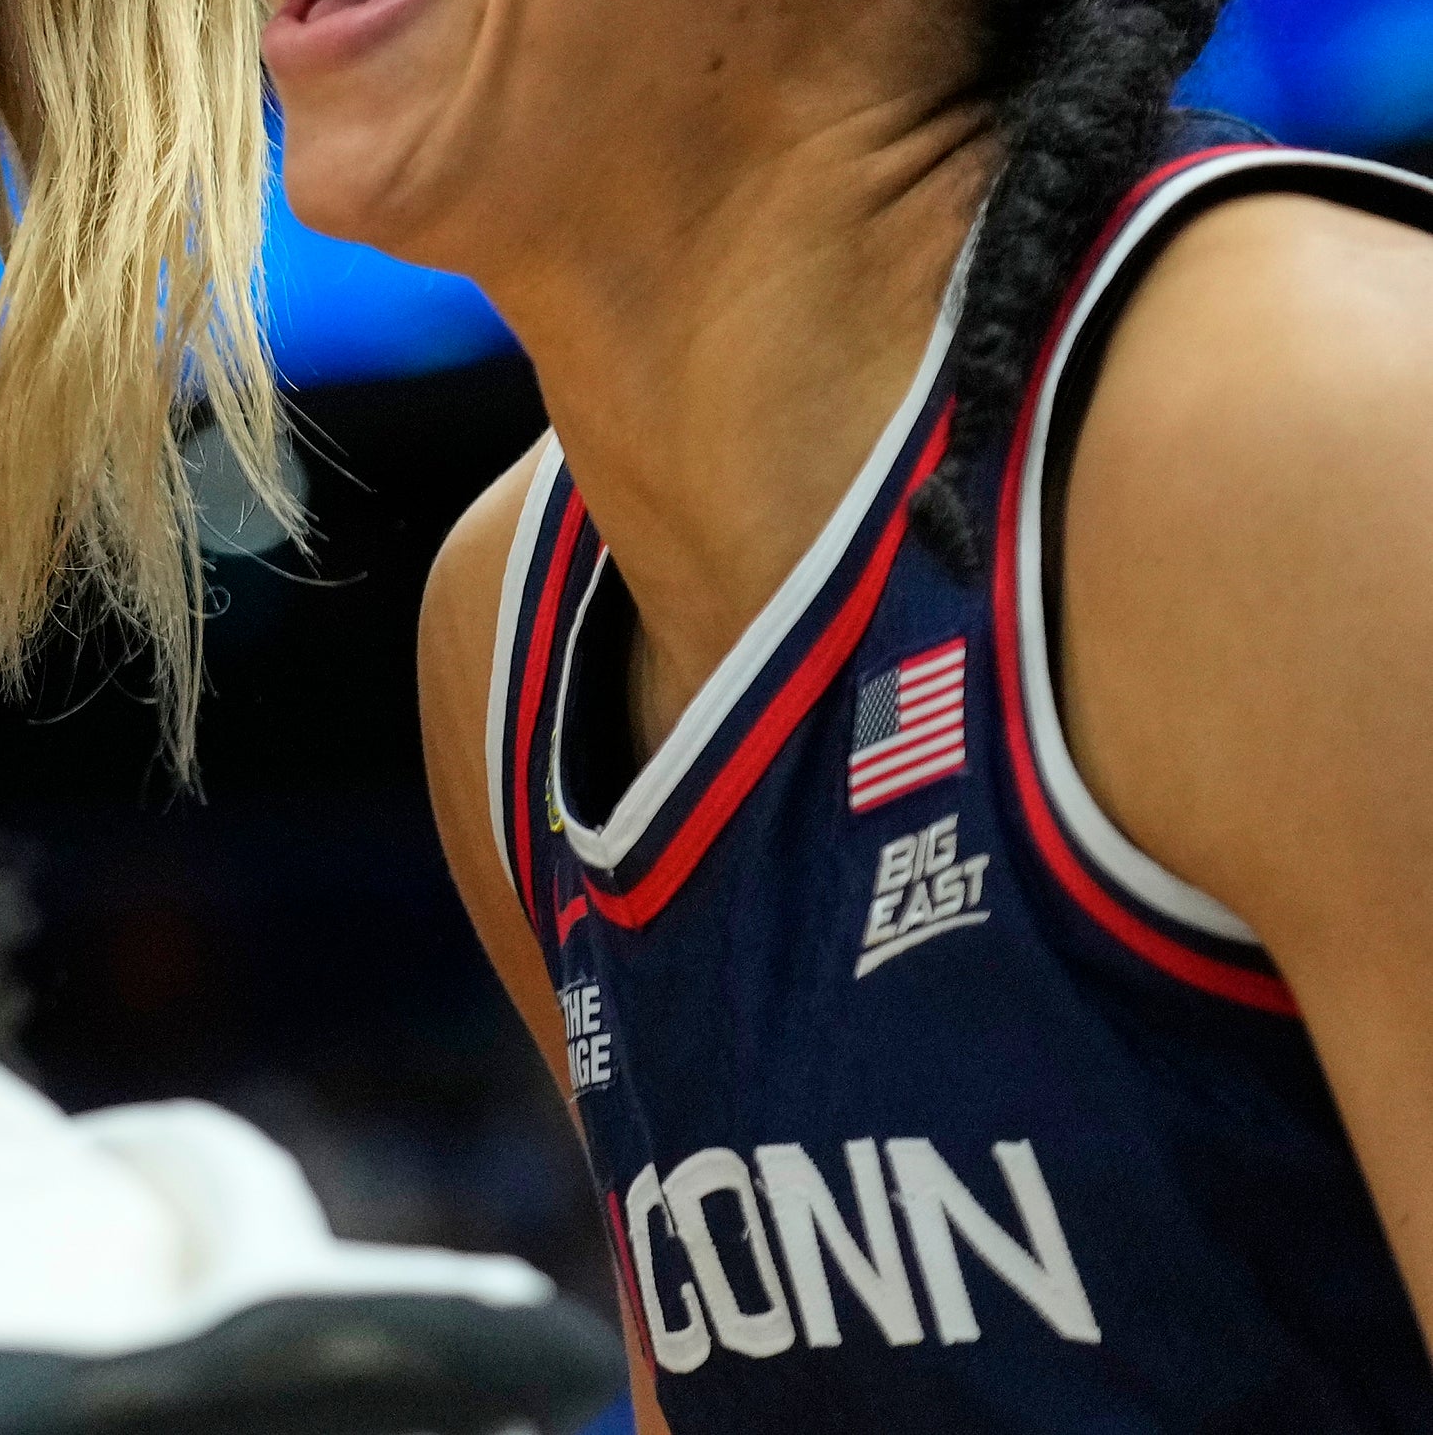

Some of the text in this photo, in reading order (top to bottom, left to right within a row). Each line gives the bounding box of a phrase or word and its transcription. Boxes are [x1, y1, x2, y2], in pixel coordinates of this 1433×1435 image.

[873, 813, 959, 898] BIG
[863, 852, 990, 947] EAST
[568, 1033, 612, 1090] NGE
